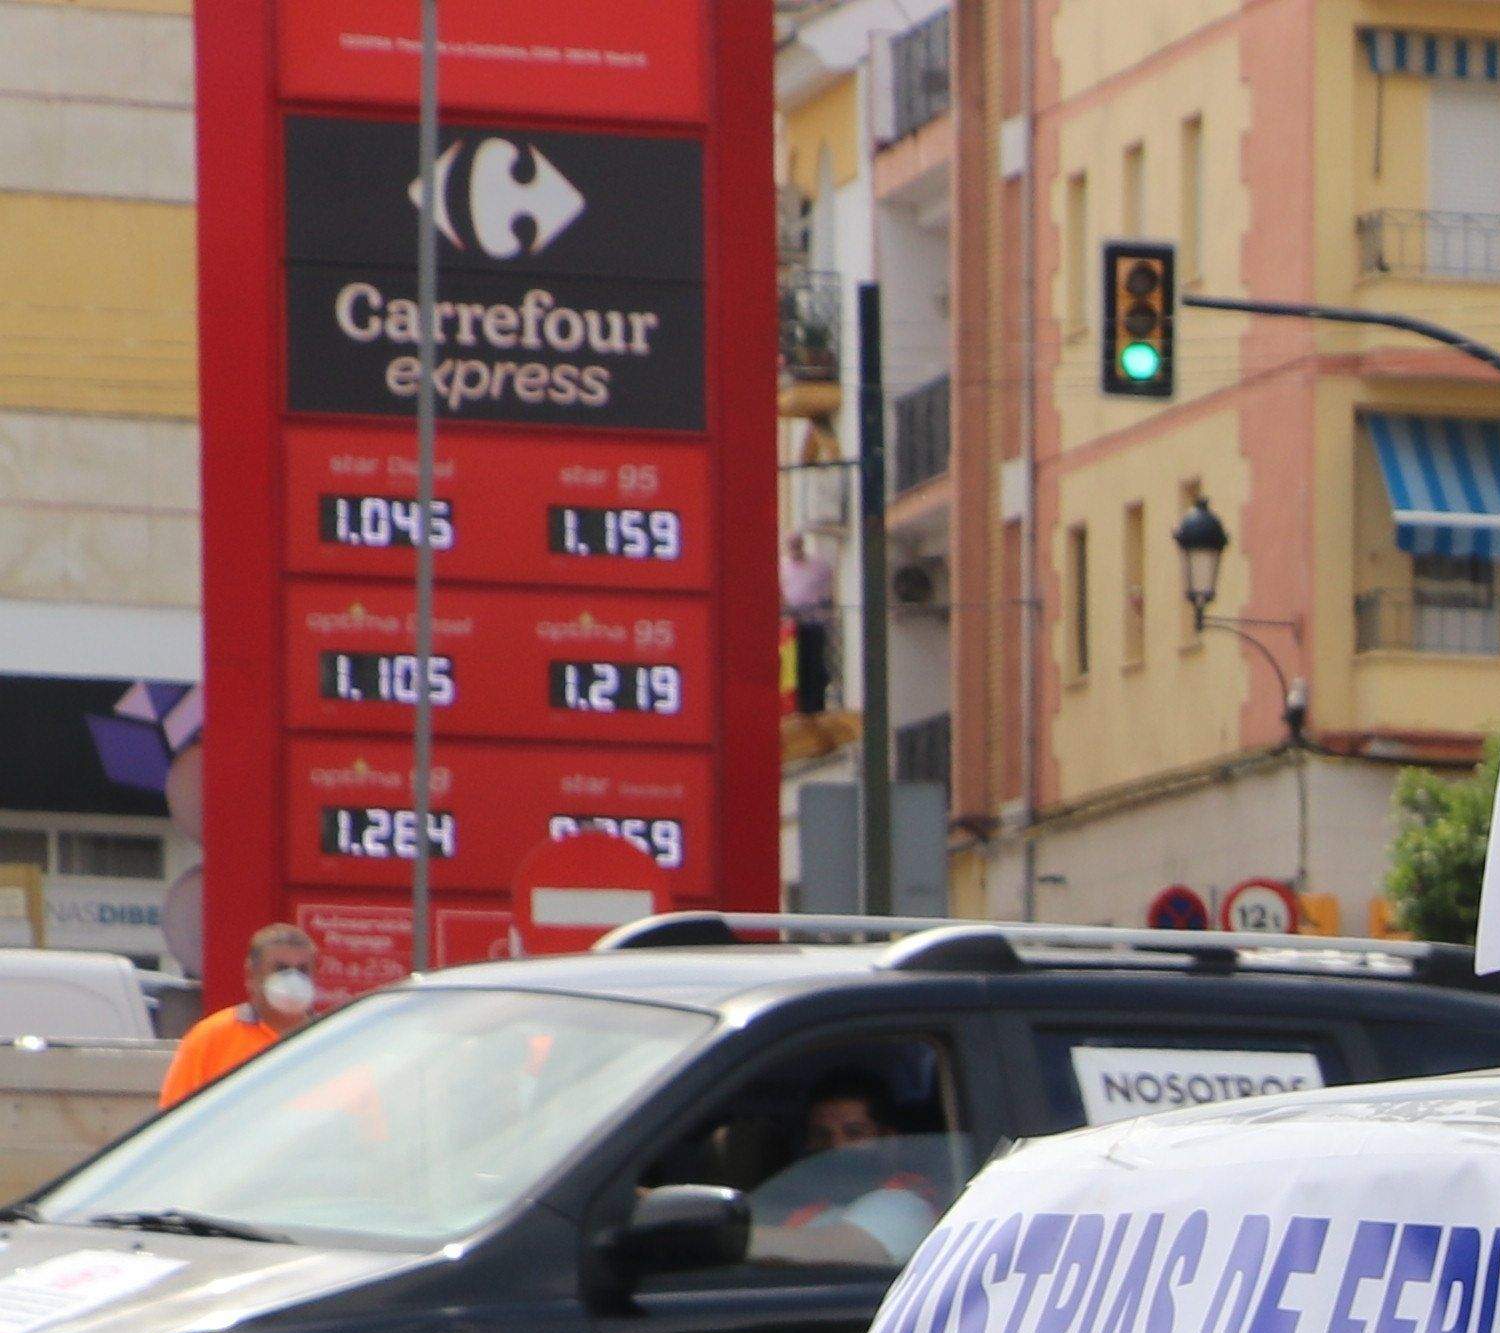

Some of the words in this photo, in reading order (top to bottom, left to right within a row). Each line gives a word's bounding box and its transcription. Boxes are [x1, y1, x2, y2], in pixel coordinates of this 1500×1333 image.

[335, 281, 658, 356] Carrefour
[617, 463, 661, 496] 95
[563, 507, 684, 561] 1.159
[634, 618, 676, 652] 95
[564, 662, 683, 715] 1.219
